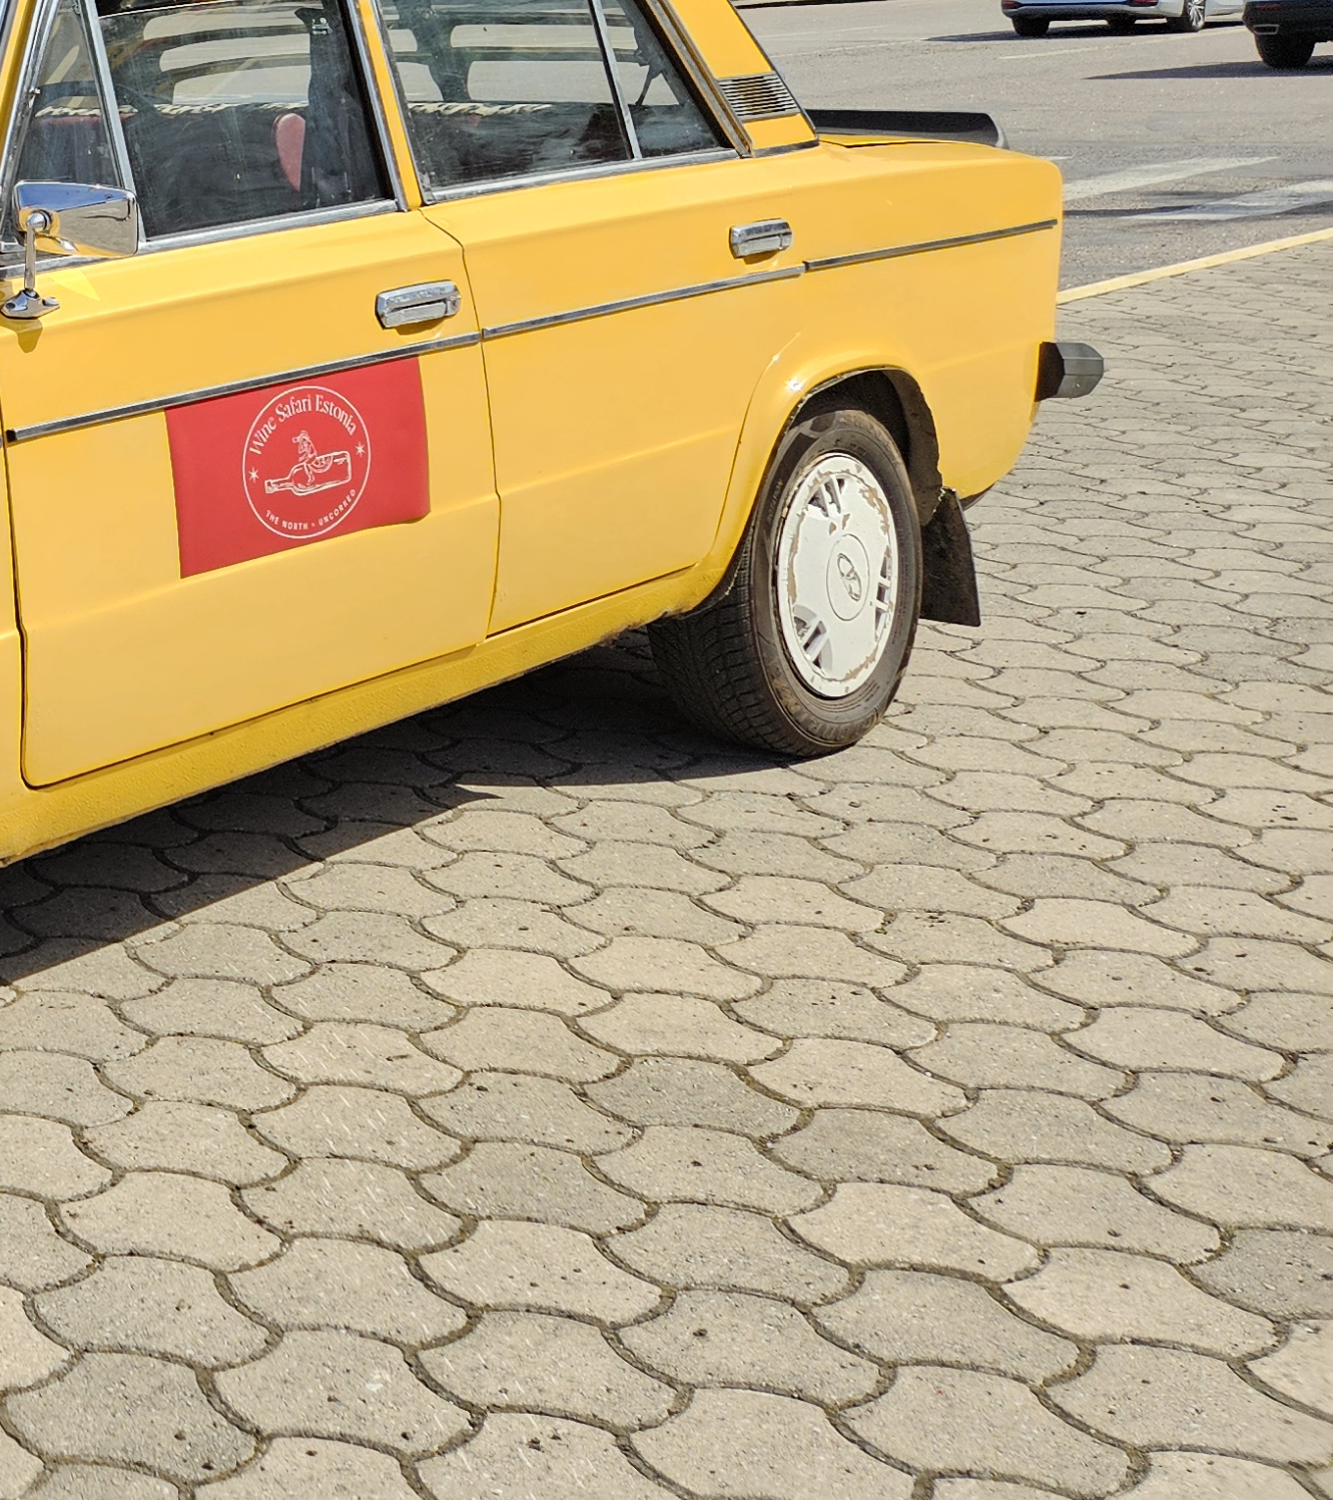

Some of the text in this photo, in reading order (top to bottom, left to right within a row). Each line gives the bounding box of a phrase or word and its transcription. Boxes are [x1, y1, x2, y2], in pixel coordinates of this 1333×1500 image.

[249, 394, 357, 455] Wine Safari Estonia
[266, 489, 356, 531] THE NORTH UNCORKED
